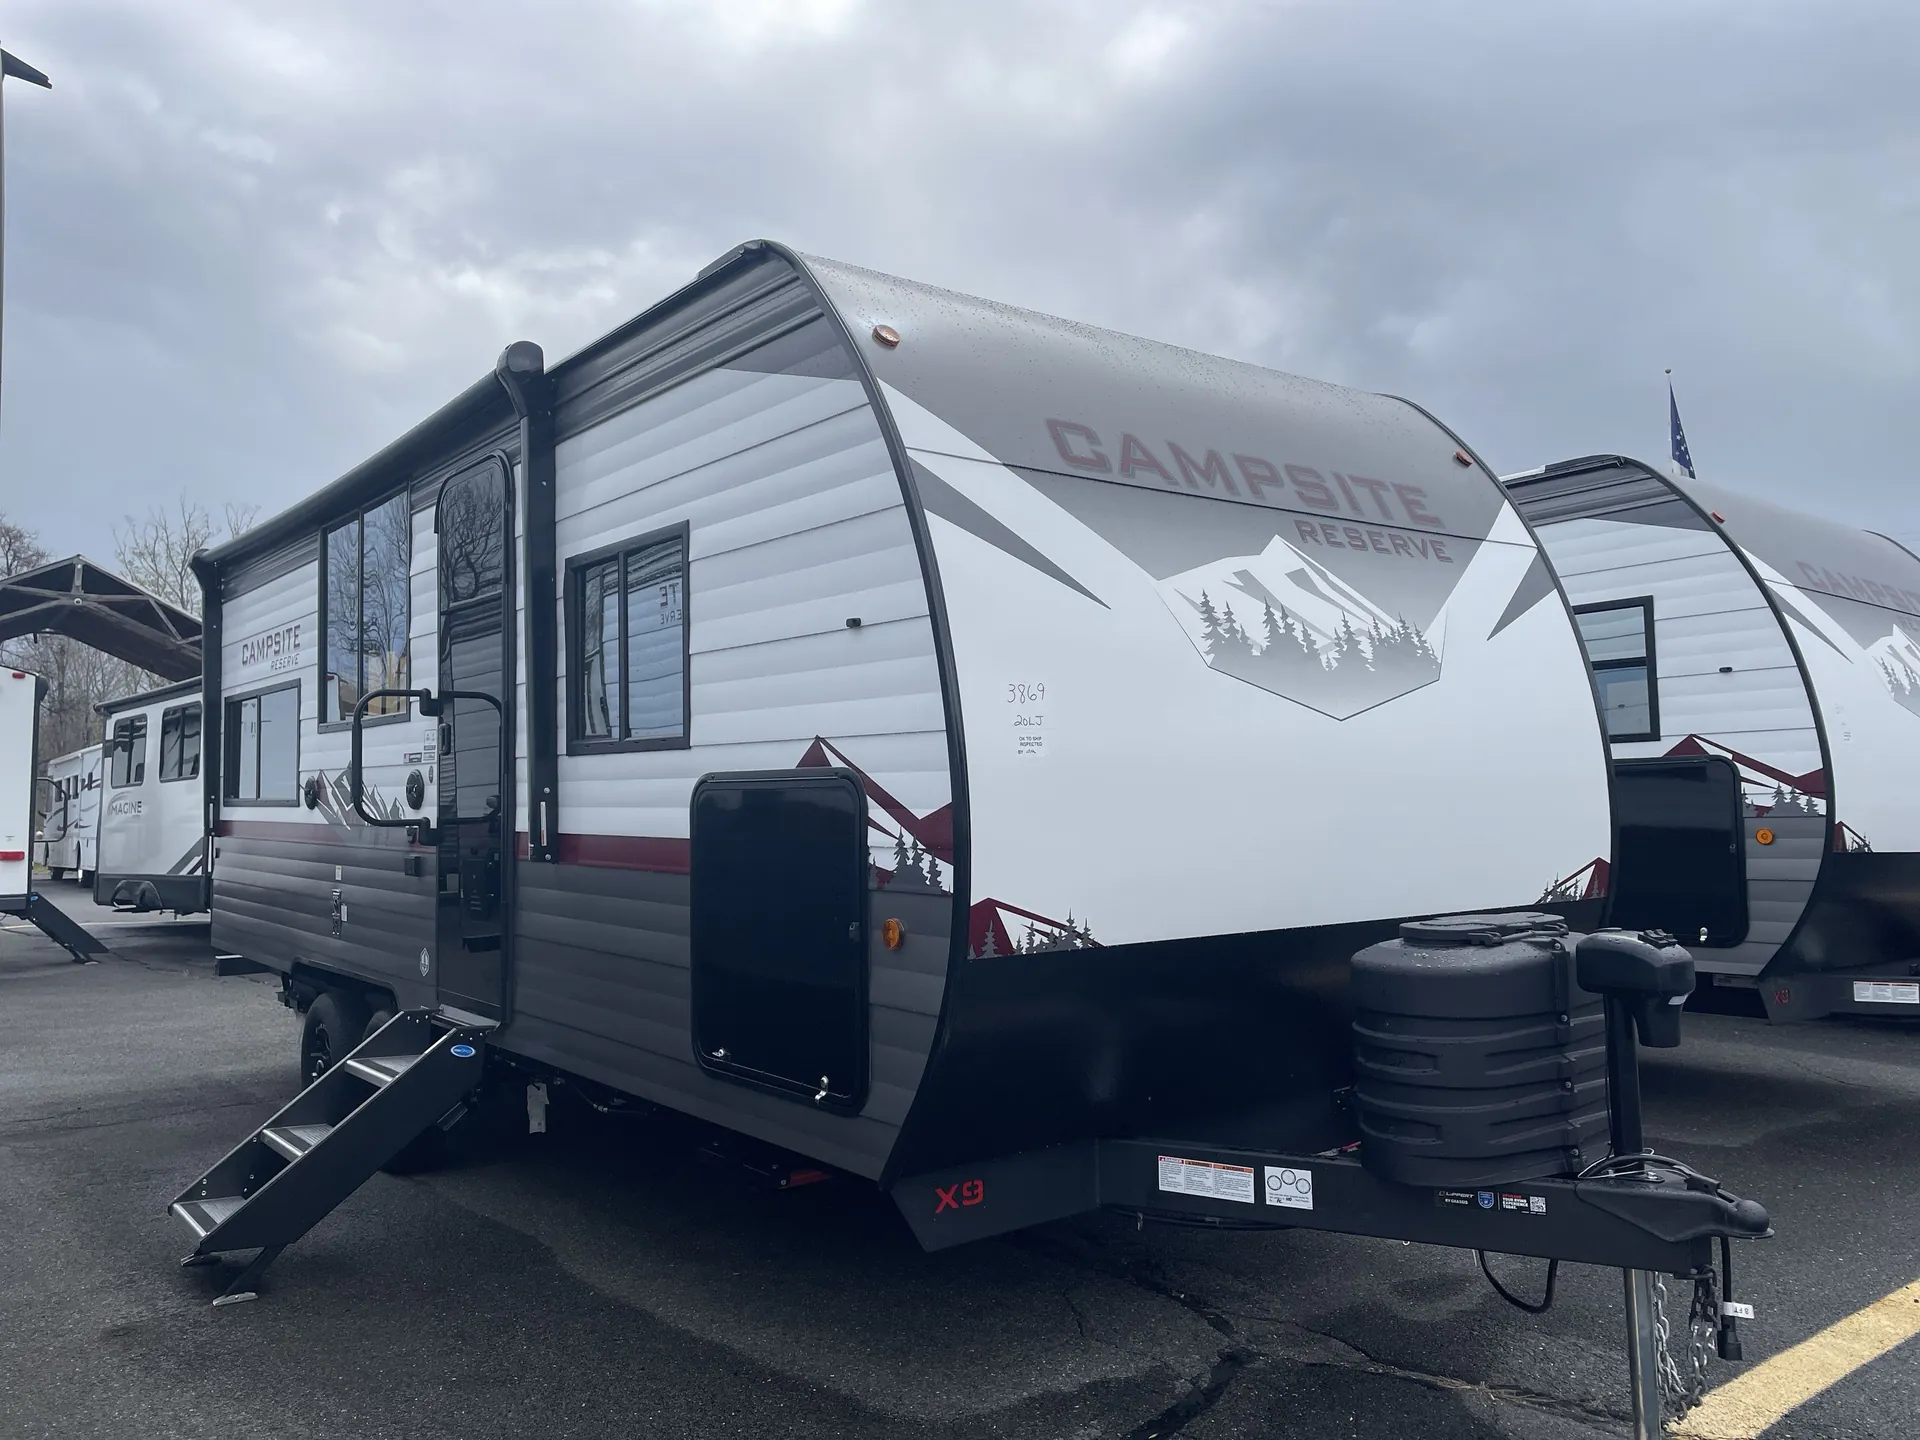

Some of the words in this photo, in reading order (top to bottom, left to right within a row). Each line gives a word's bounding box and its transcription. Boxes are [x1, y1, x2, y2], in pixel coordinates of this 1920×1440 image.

[1045, 417, 1446, 530] CAMPSITE
[1293, 519, 1454, 564] RESERVE
[242, 624, 301, 666] CAMPSITE
[270, 653, 300, 671] RESERVE
[1007, 683, 1045, 704] 3869
[935, 1179, 984, 1214] X9
